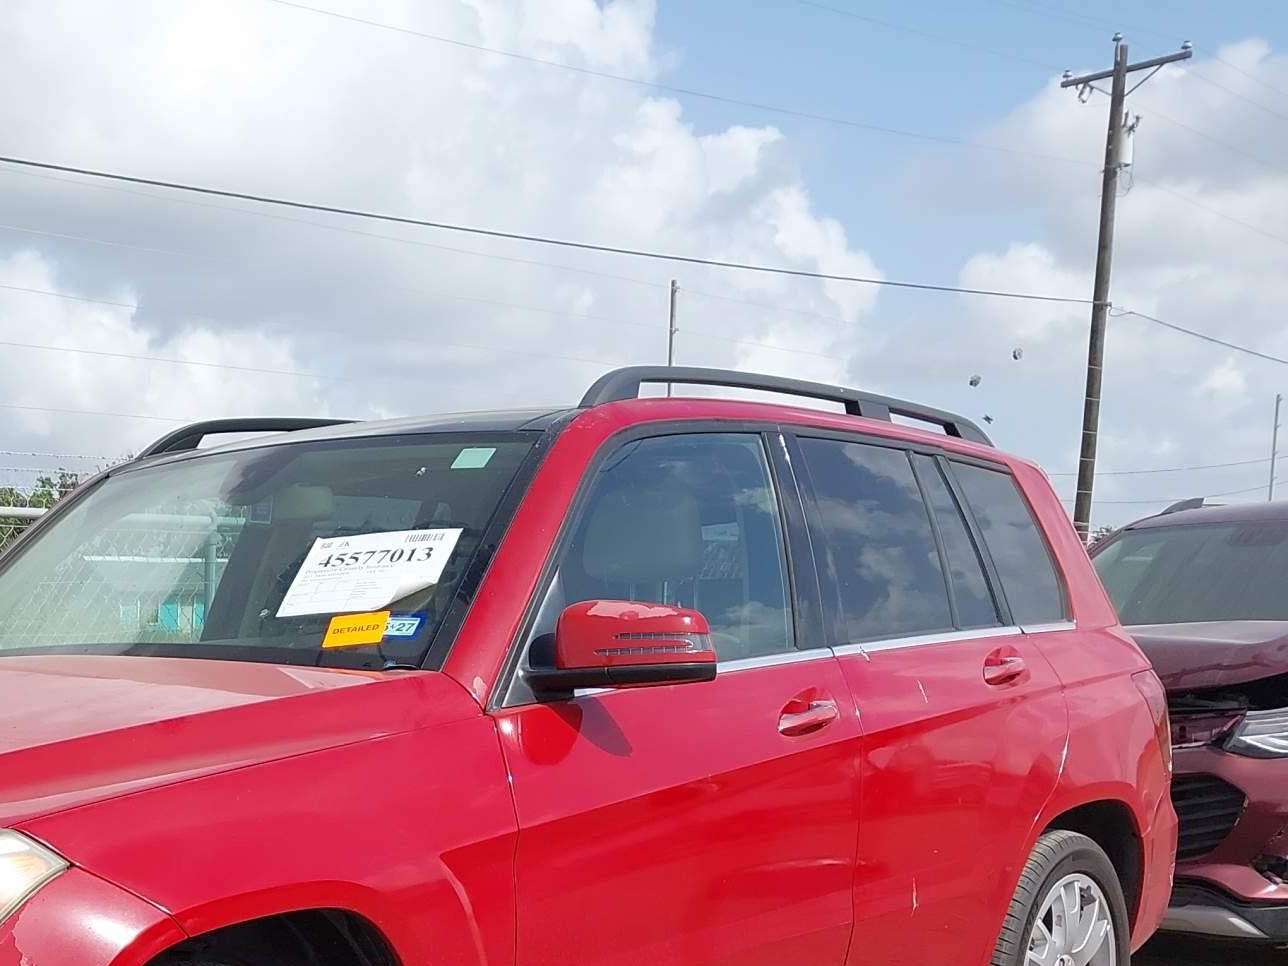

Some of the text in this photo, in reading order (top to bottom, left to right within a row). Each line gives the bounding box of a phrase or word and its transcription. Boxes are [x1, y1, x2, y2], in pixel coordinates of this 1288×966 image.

[318, 547, 434, 567] 45577013
[332, 623, 380, 635] DETAILED
[395, 622, 416, 632] 27
